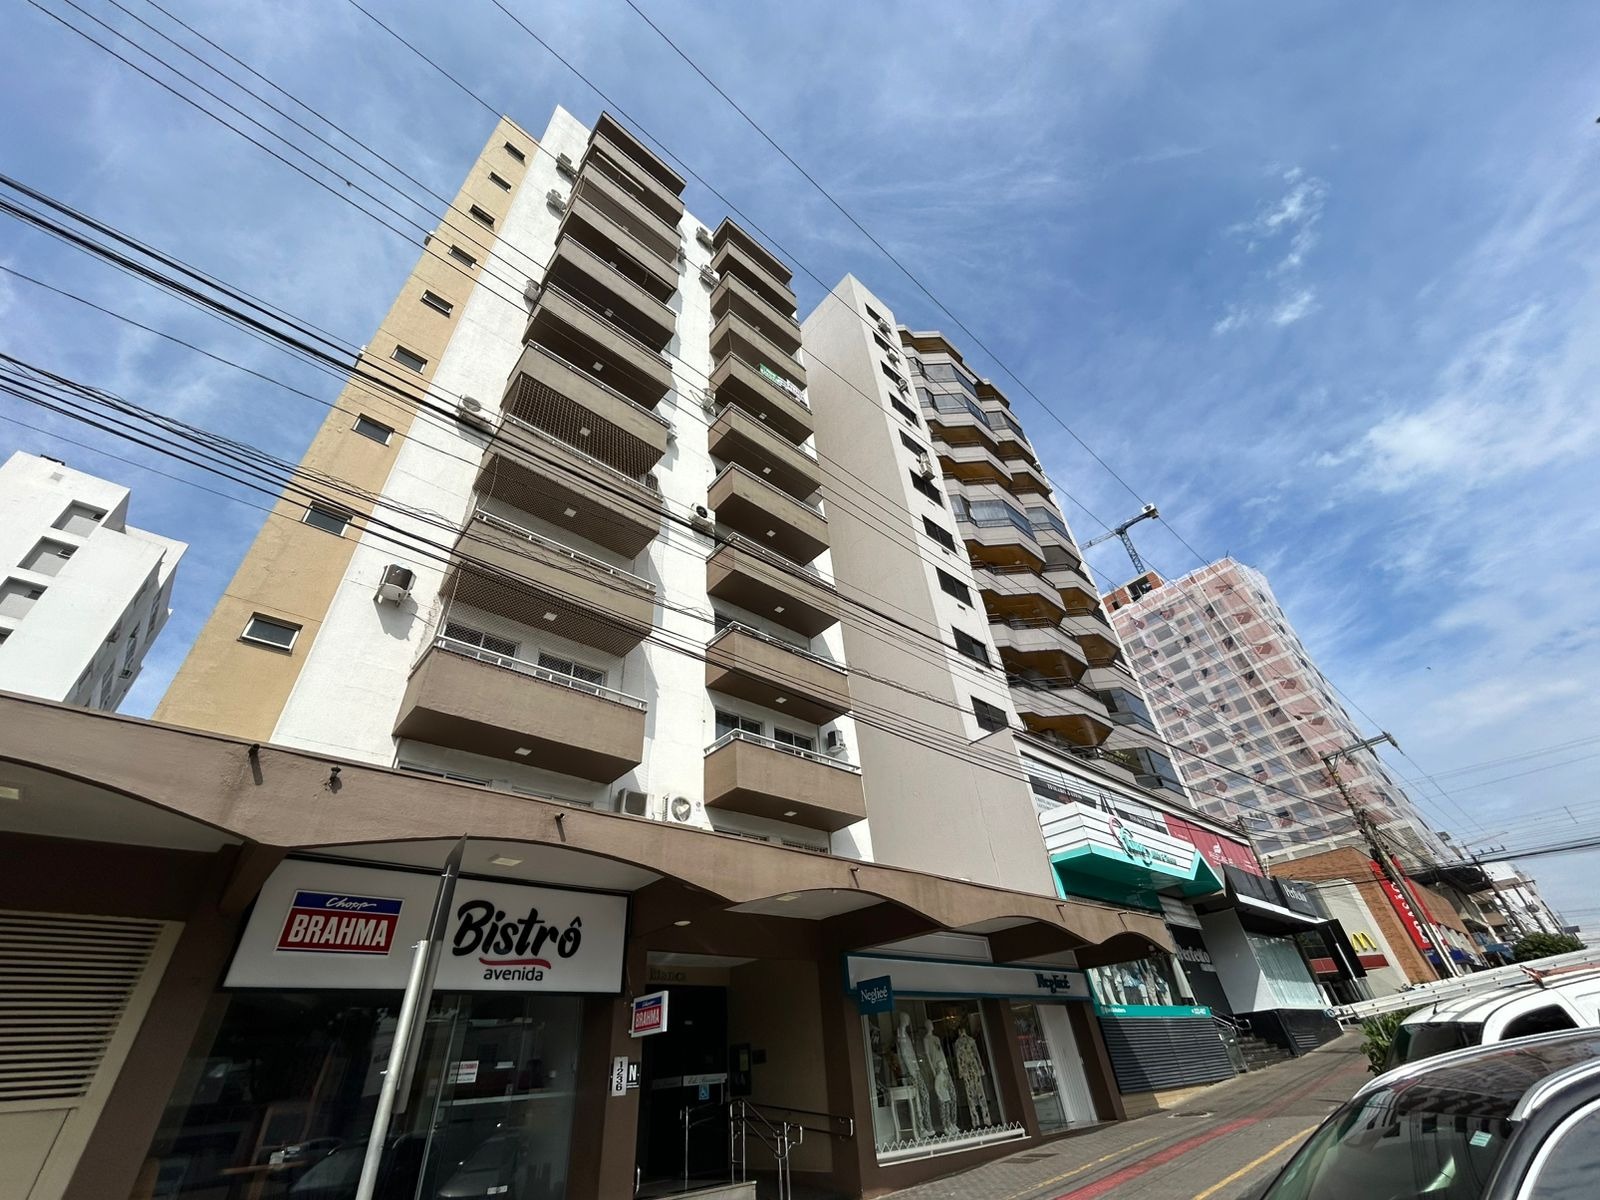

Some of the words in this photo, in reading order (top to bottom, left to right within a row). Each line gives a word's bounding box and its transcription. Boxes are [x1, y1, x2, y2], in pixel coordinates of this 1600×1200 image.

[325, 897, 377, 911] Chopp
[287, 913, 389, 947] BRAHMA
[452, 899, 582, 959] Bistrô
[483, 966, 544, 982] avenida
[635, 1007, 660, 1029] BRAHMA
[615, 1060, 624, 1092] 1236
